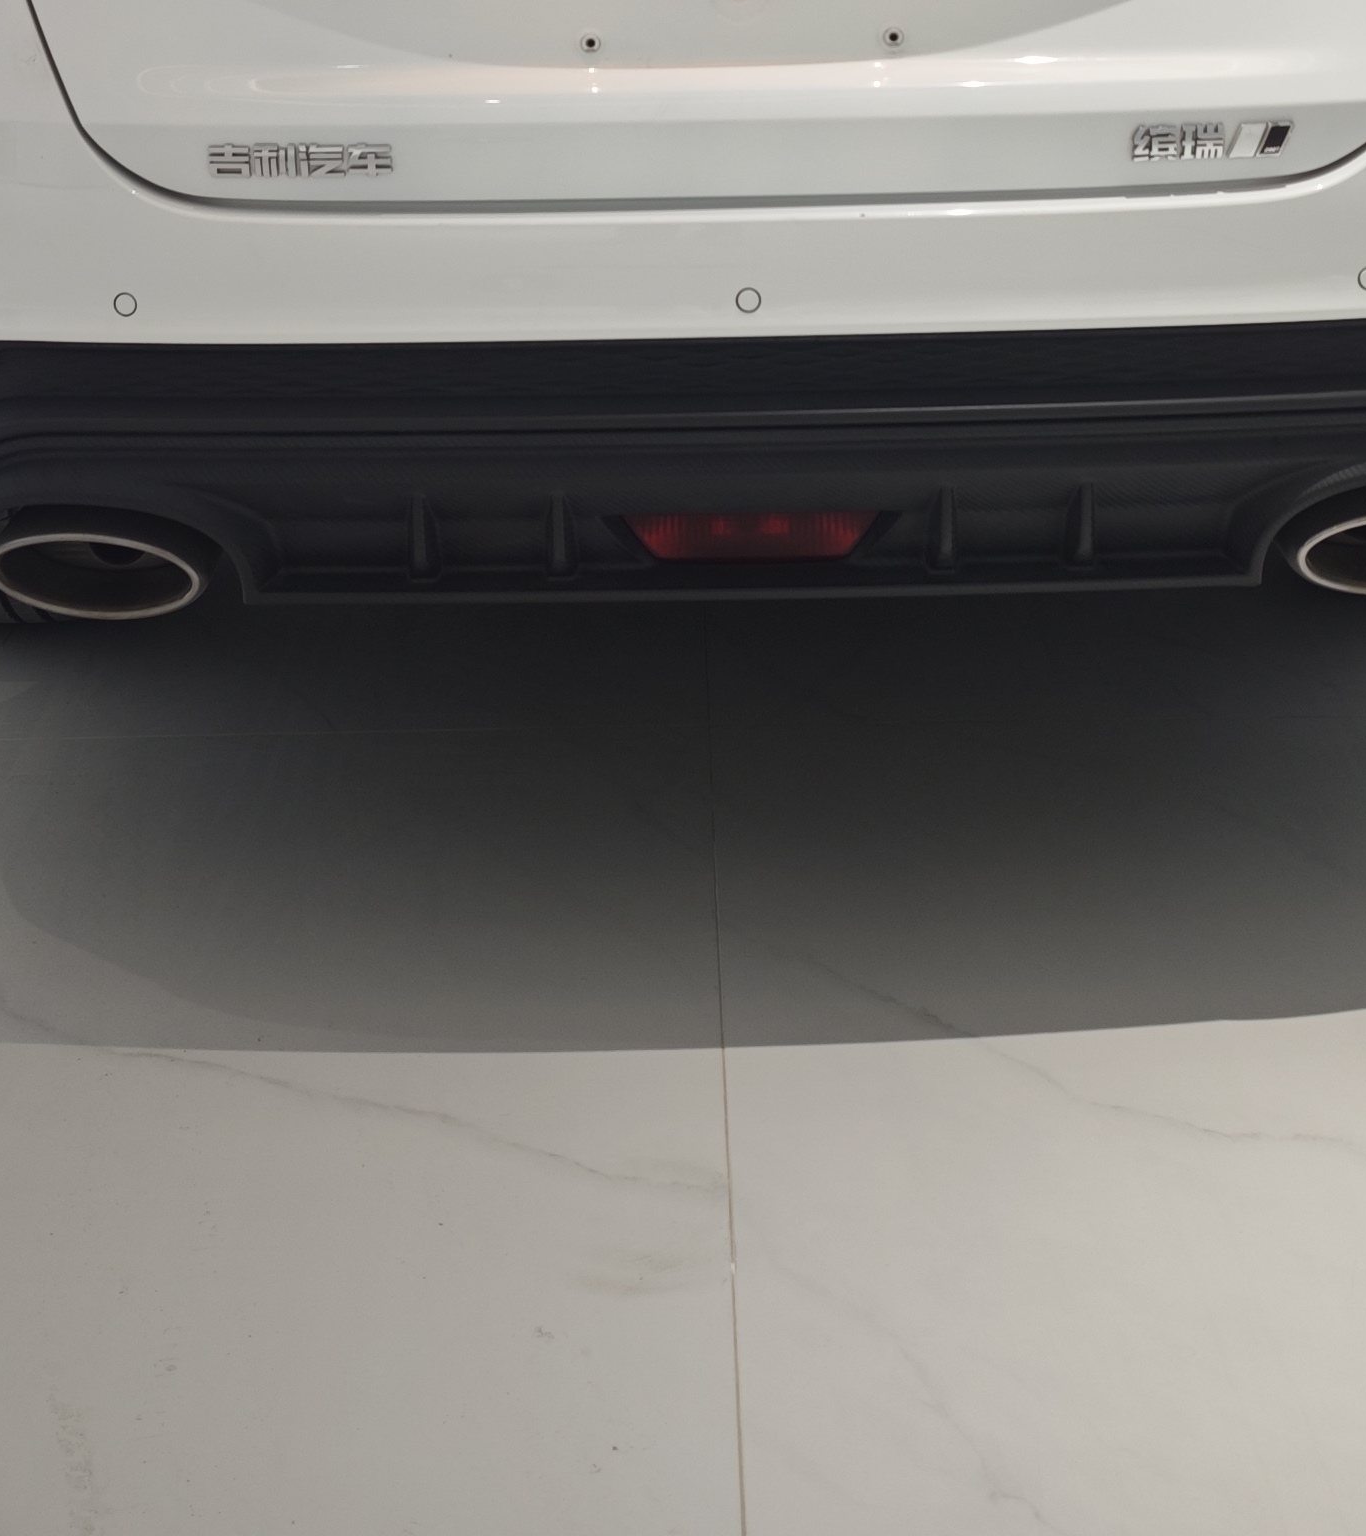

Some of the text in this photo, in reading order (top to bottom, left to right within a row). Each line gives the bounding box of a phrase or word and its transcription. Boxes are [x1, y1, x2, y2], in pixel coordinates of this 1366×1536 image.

[208, 143, 393, 178] 吉利汽车
[1132, 123, 1225, 162] 缤瑞
